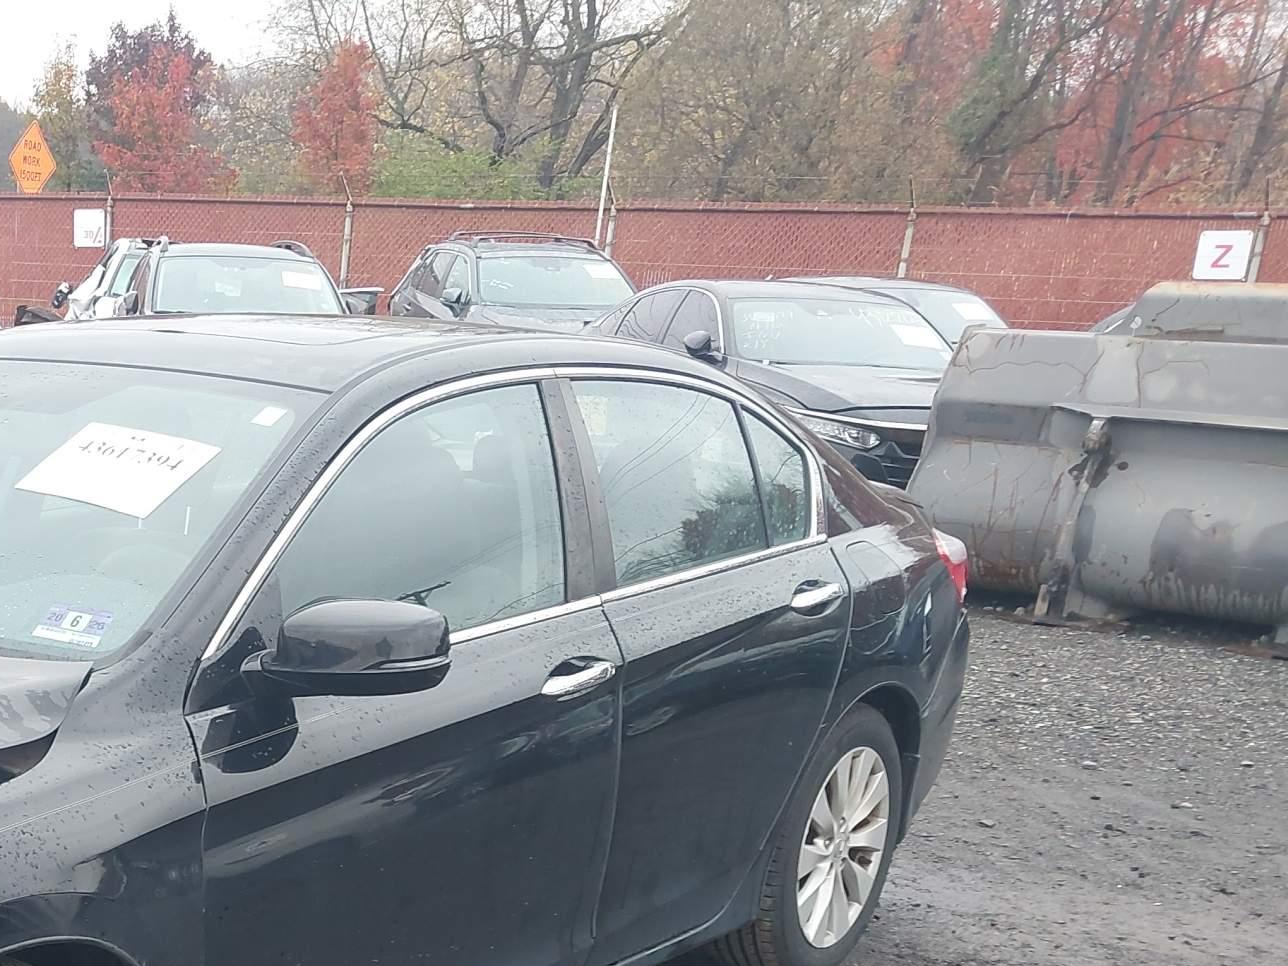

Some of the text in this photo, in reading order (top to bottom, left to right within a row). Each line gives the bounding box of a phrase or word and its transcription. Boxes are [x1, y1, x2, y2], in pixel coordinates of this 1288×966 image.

[23, 140, 42, 152] ROAD
[22, 155, 41, 167] WORK
[1210, 244, 1234, 269] Z
[70, 615, 82, 628] 6
